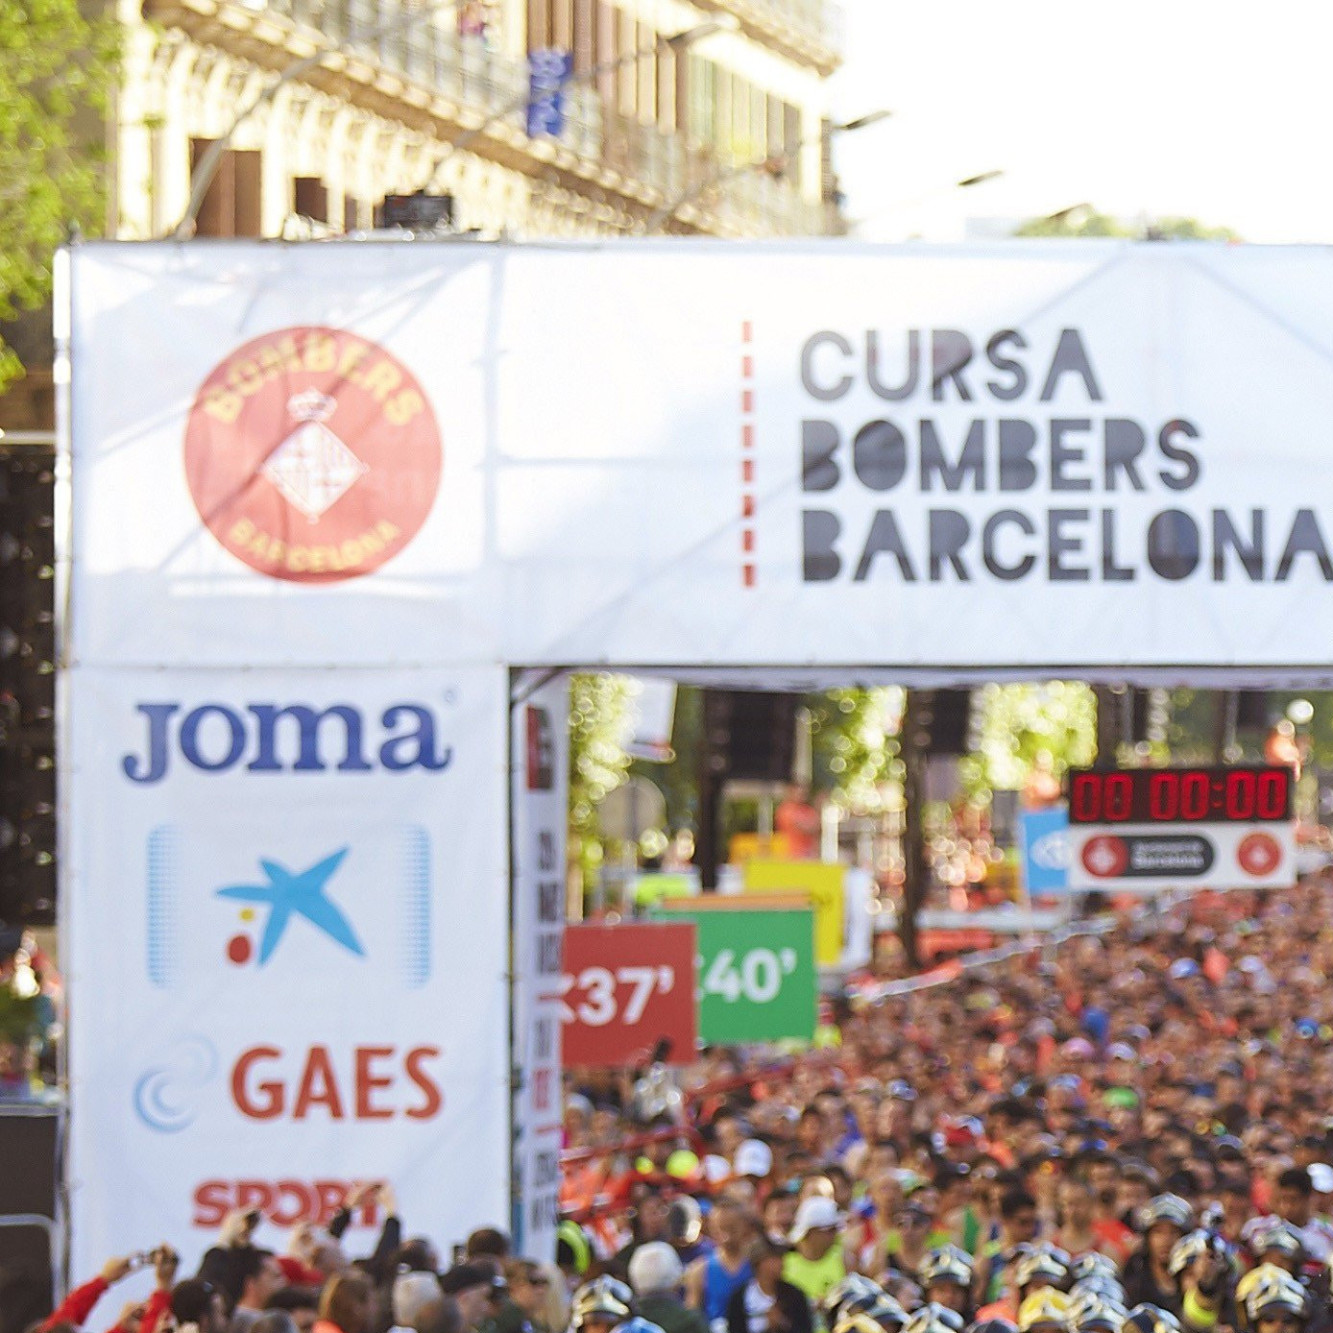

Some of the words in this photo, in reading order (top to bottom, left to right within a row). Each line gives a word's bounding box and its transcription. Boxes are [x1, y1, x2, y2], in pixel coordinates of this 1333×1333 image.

[203, 331, 426, 426] BOMBERS
[800, 329, 1104, 401] CURSA
[801, 418, 1202, 492] BOMBERS
[228, 515, 402, 574] BARCELONA
[231, 1044, 442, 1123] GAES
